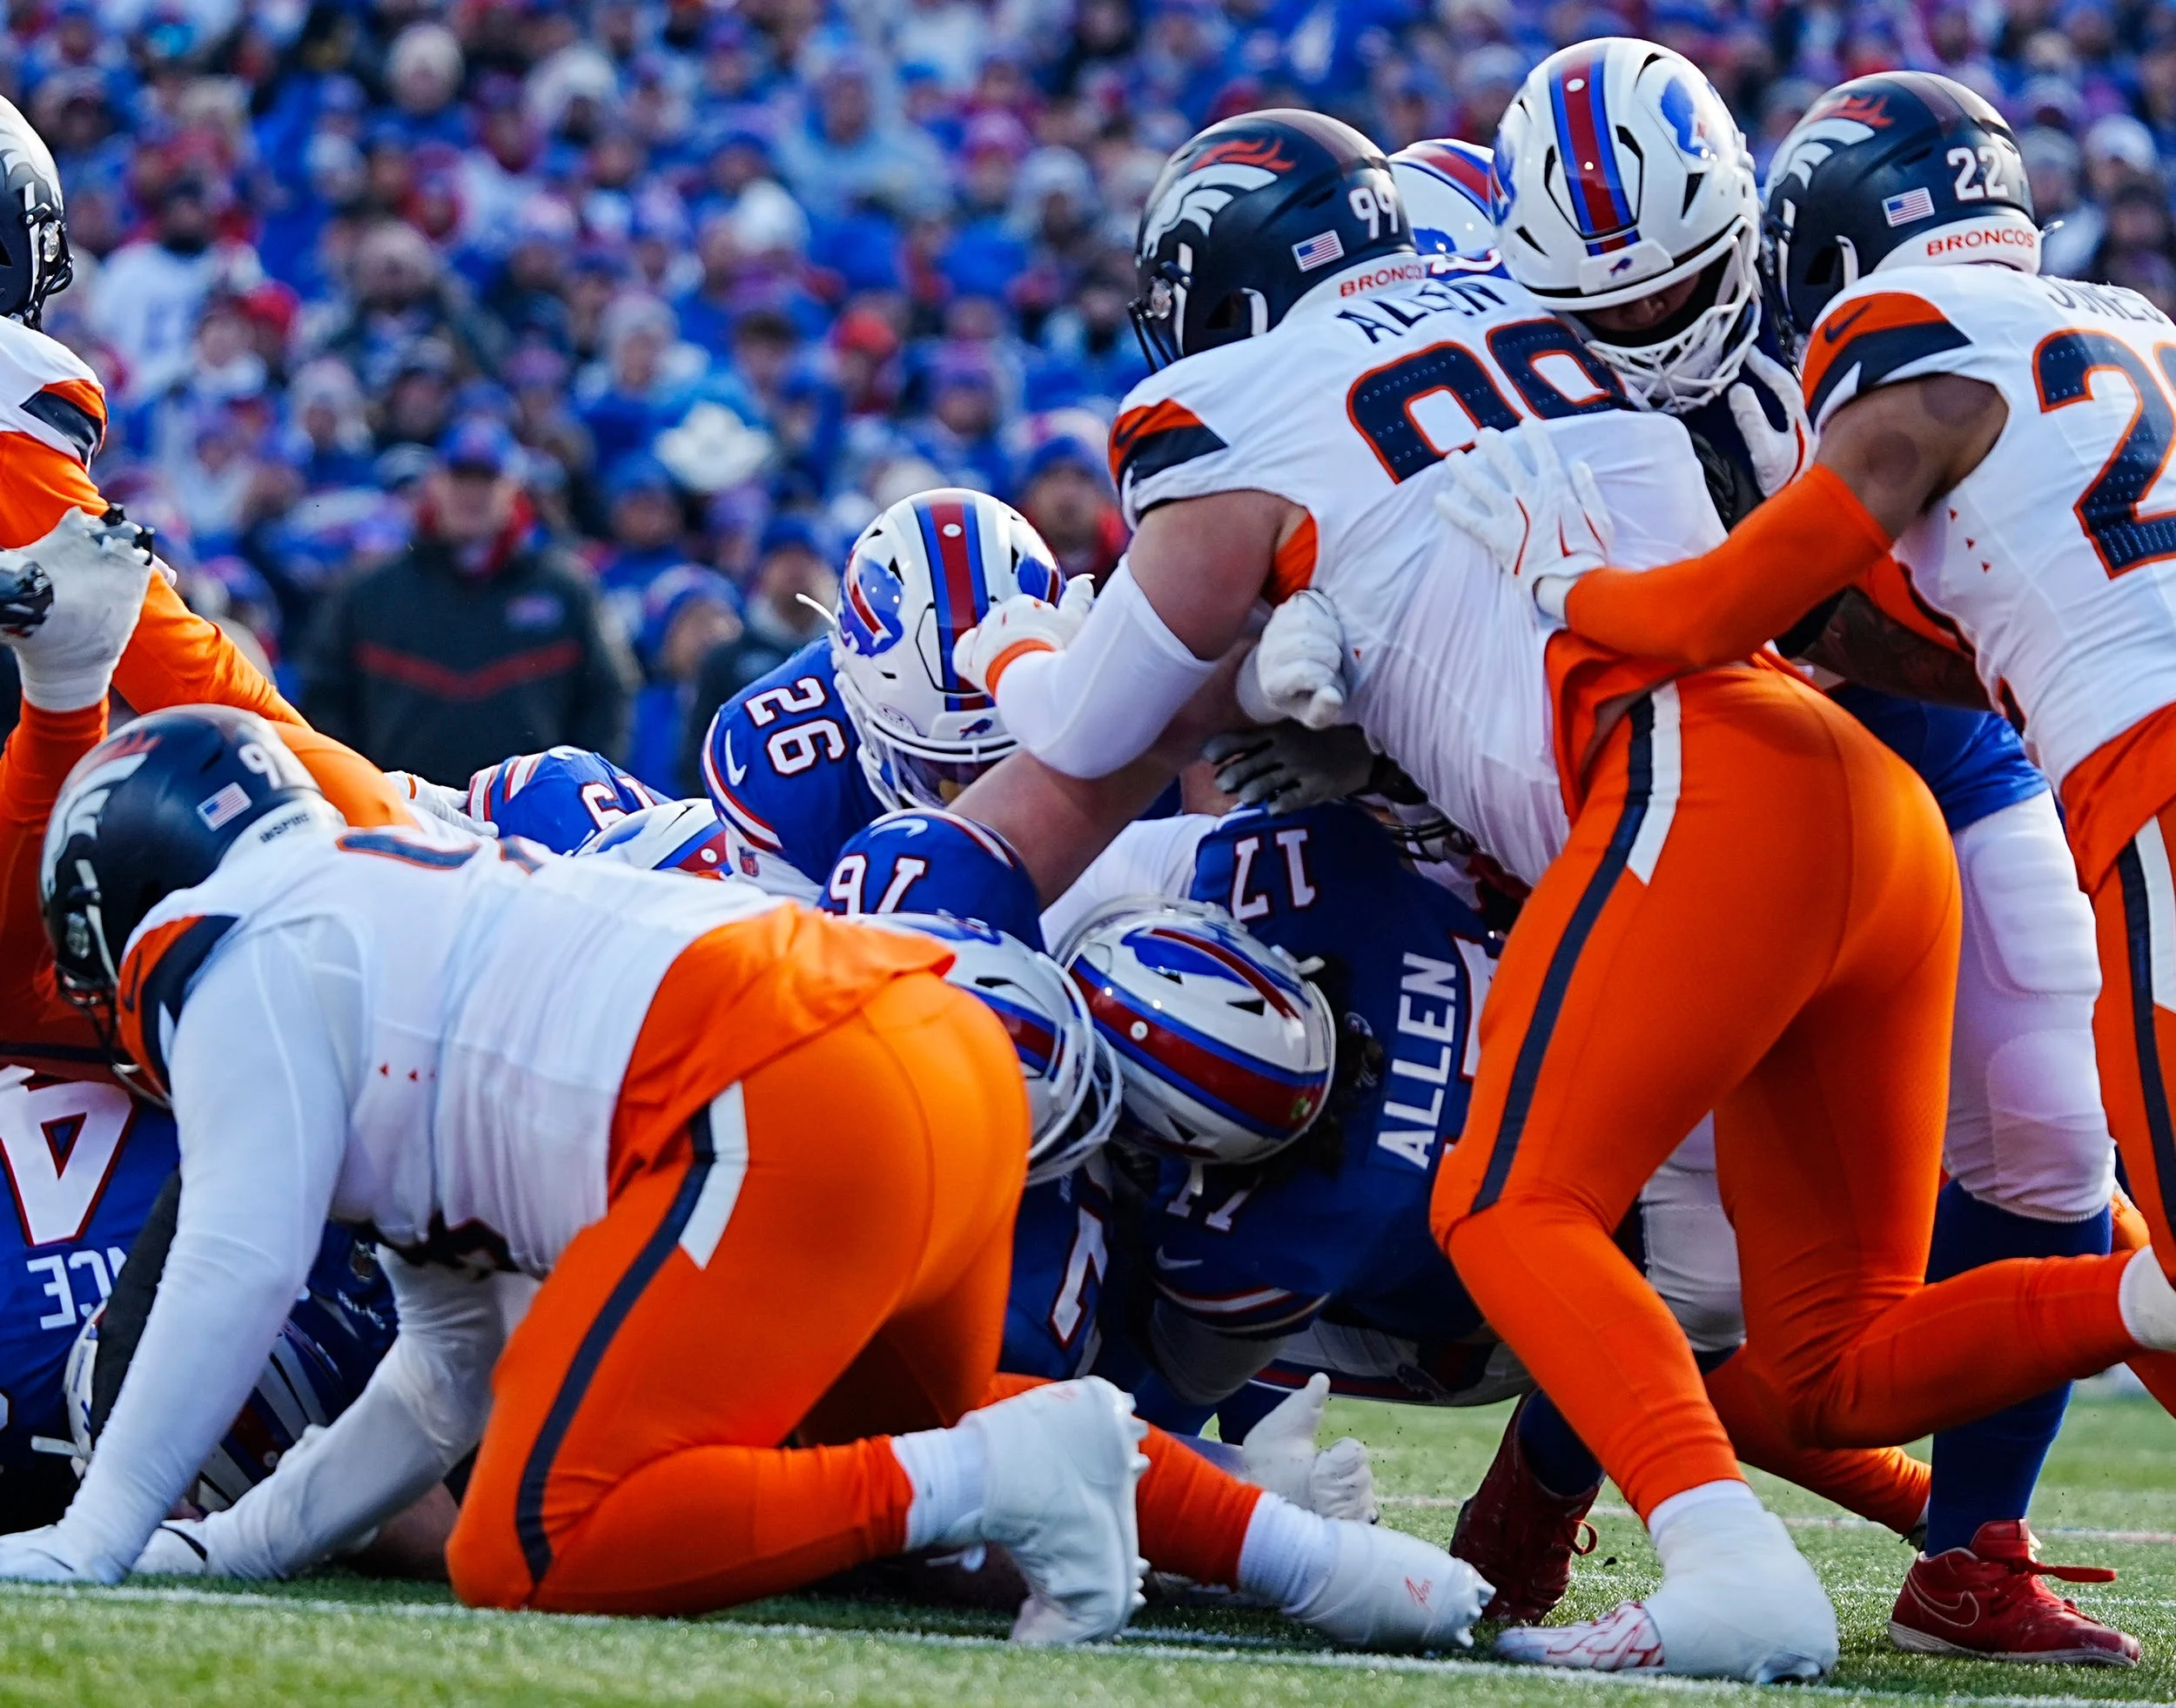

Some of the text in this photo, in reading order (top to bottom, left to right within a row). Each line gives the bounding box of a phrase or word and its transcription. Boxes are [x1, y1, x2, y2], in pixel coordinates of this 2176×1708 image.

[1349, 186, 1399, 239] 99
[1947, 147, 2009, 200] 22
[1926, 228, 2034, 256] BRONCOS
[1335, 281, 1508, 344] ALLN
[2032, 328, 2176, 580] 2
[744, 676, 849, 776] 26
[1231, 828, 1317, 921] 17
[1377, 952, 1456, 1170] ALLEN
